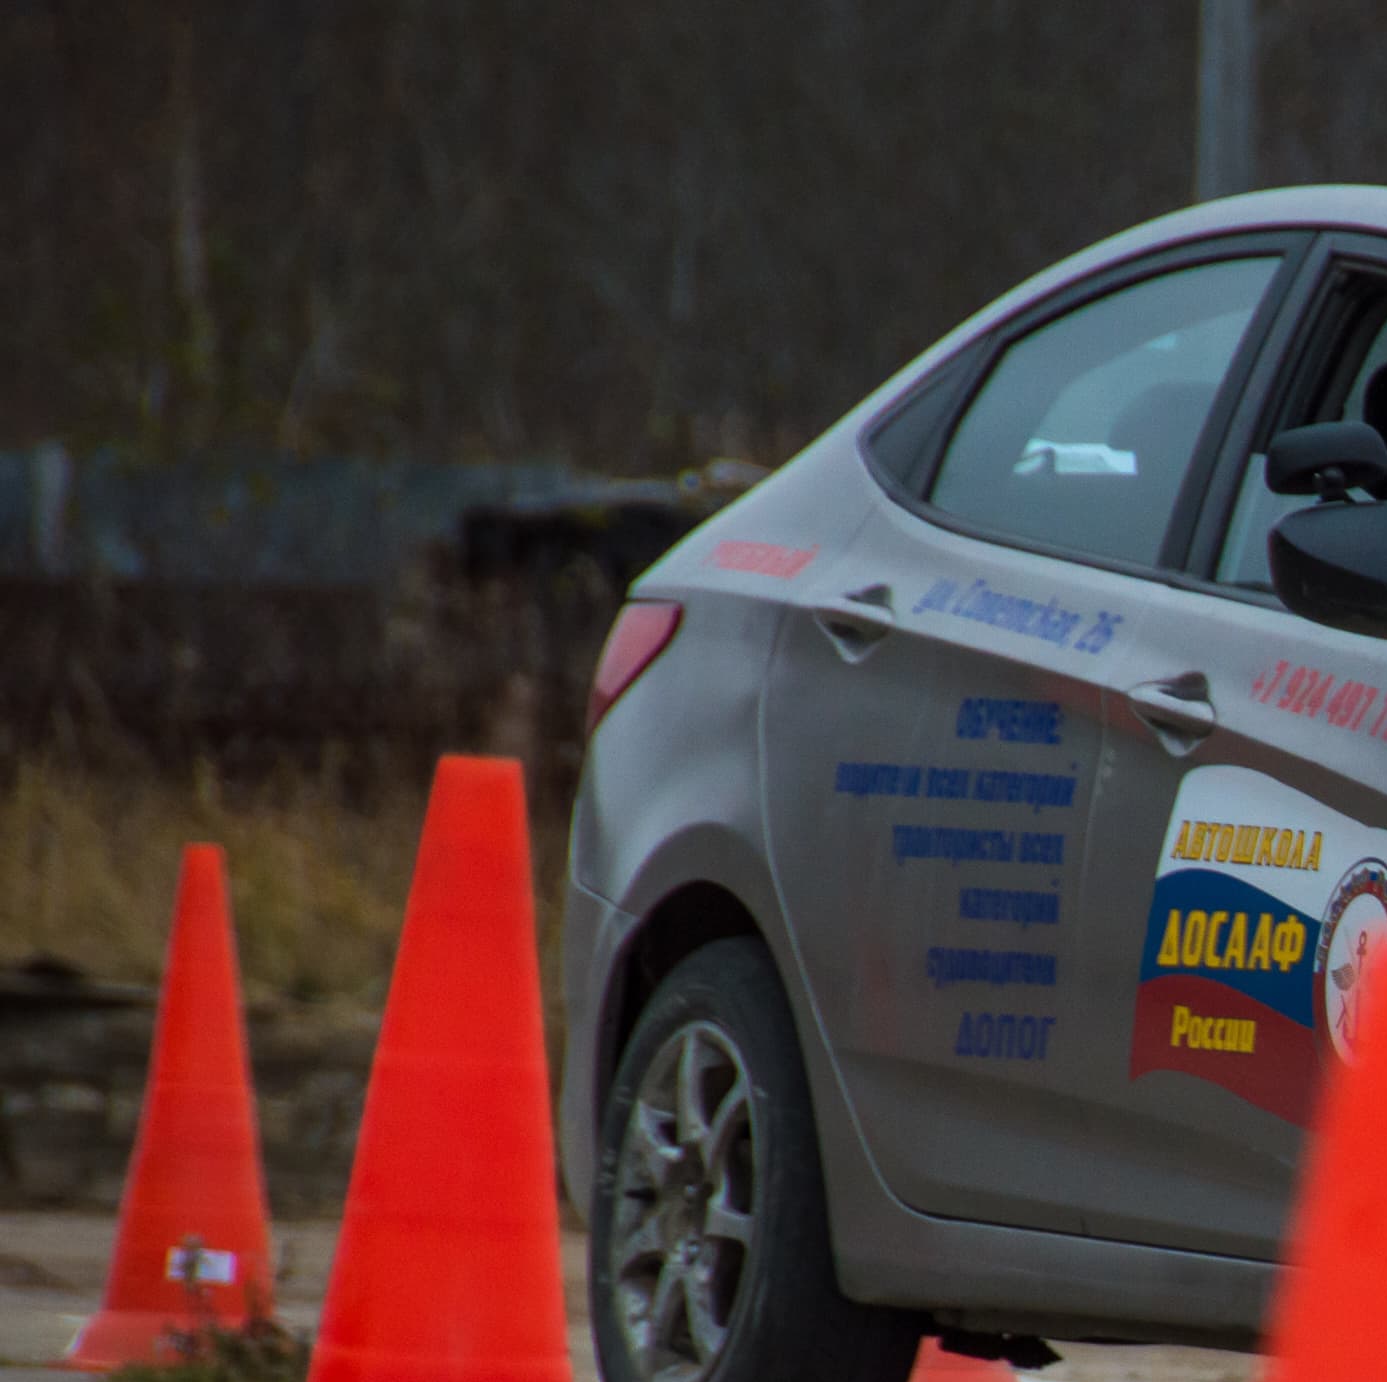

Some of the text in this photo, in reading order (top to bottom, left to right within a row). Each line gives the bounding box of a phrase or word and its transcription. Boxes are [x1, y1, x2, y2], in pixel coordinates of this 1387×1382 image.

[1277, 666, 1338, 722] 924
[1171, 819, 1322, 873] АВТОШКОЛА
[1156, 908, 1308, 974] ДОСААФ
[954, 1010, 1057, 1060] ДОПОГ
[1169, 1004, 1257, 1054] России
